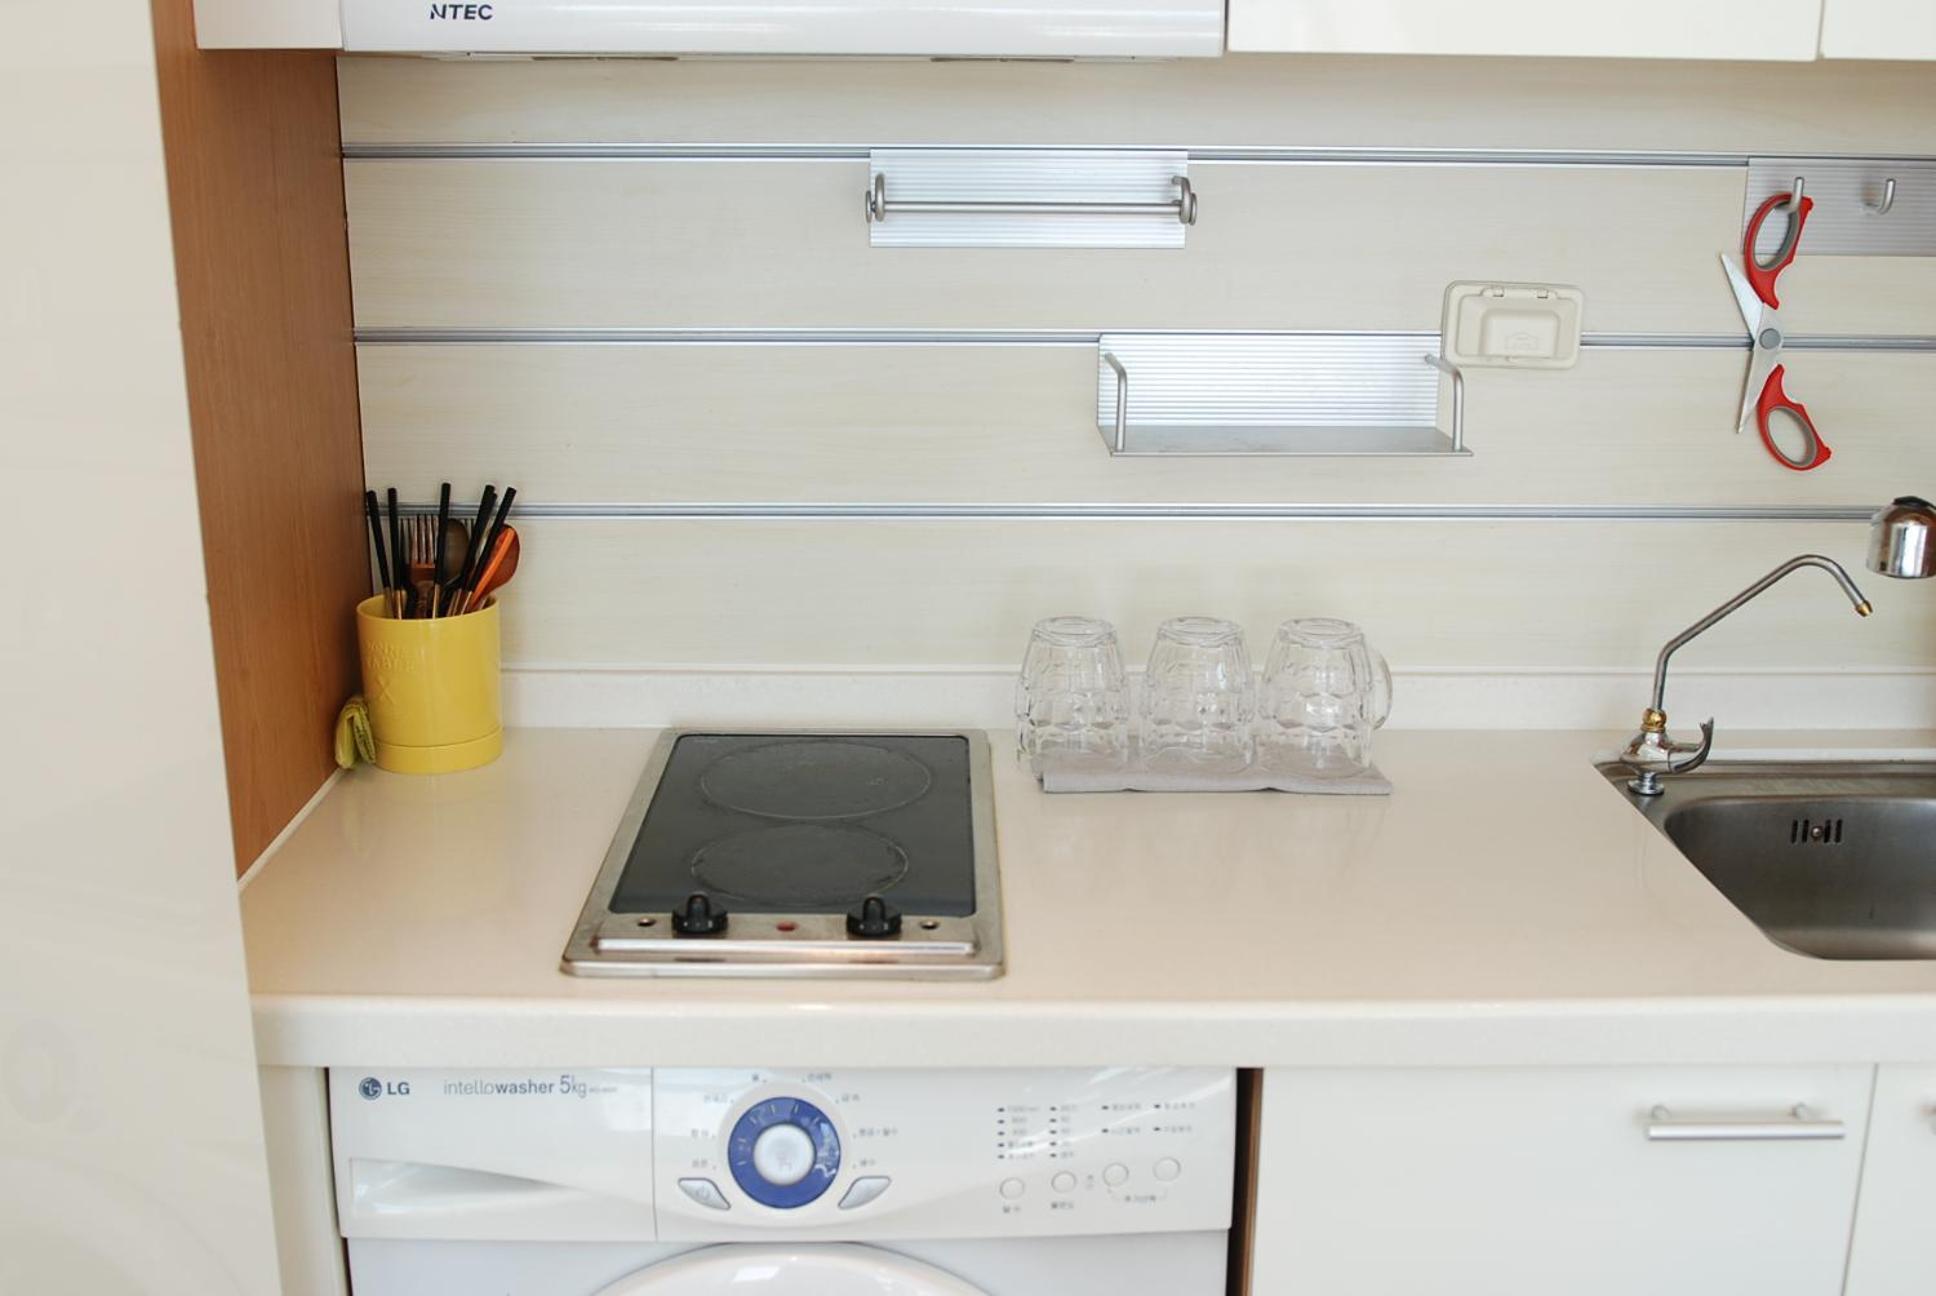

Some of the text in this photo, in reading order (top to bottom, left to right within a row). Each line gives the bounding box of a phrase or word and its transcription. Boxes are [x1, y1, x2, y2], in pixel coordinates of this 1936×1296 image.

[387, 1081, 410, 1096] LG
[443, 1074, 587, 1098] intellowasher 5kg
